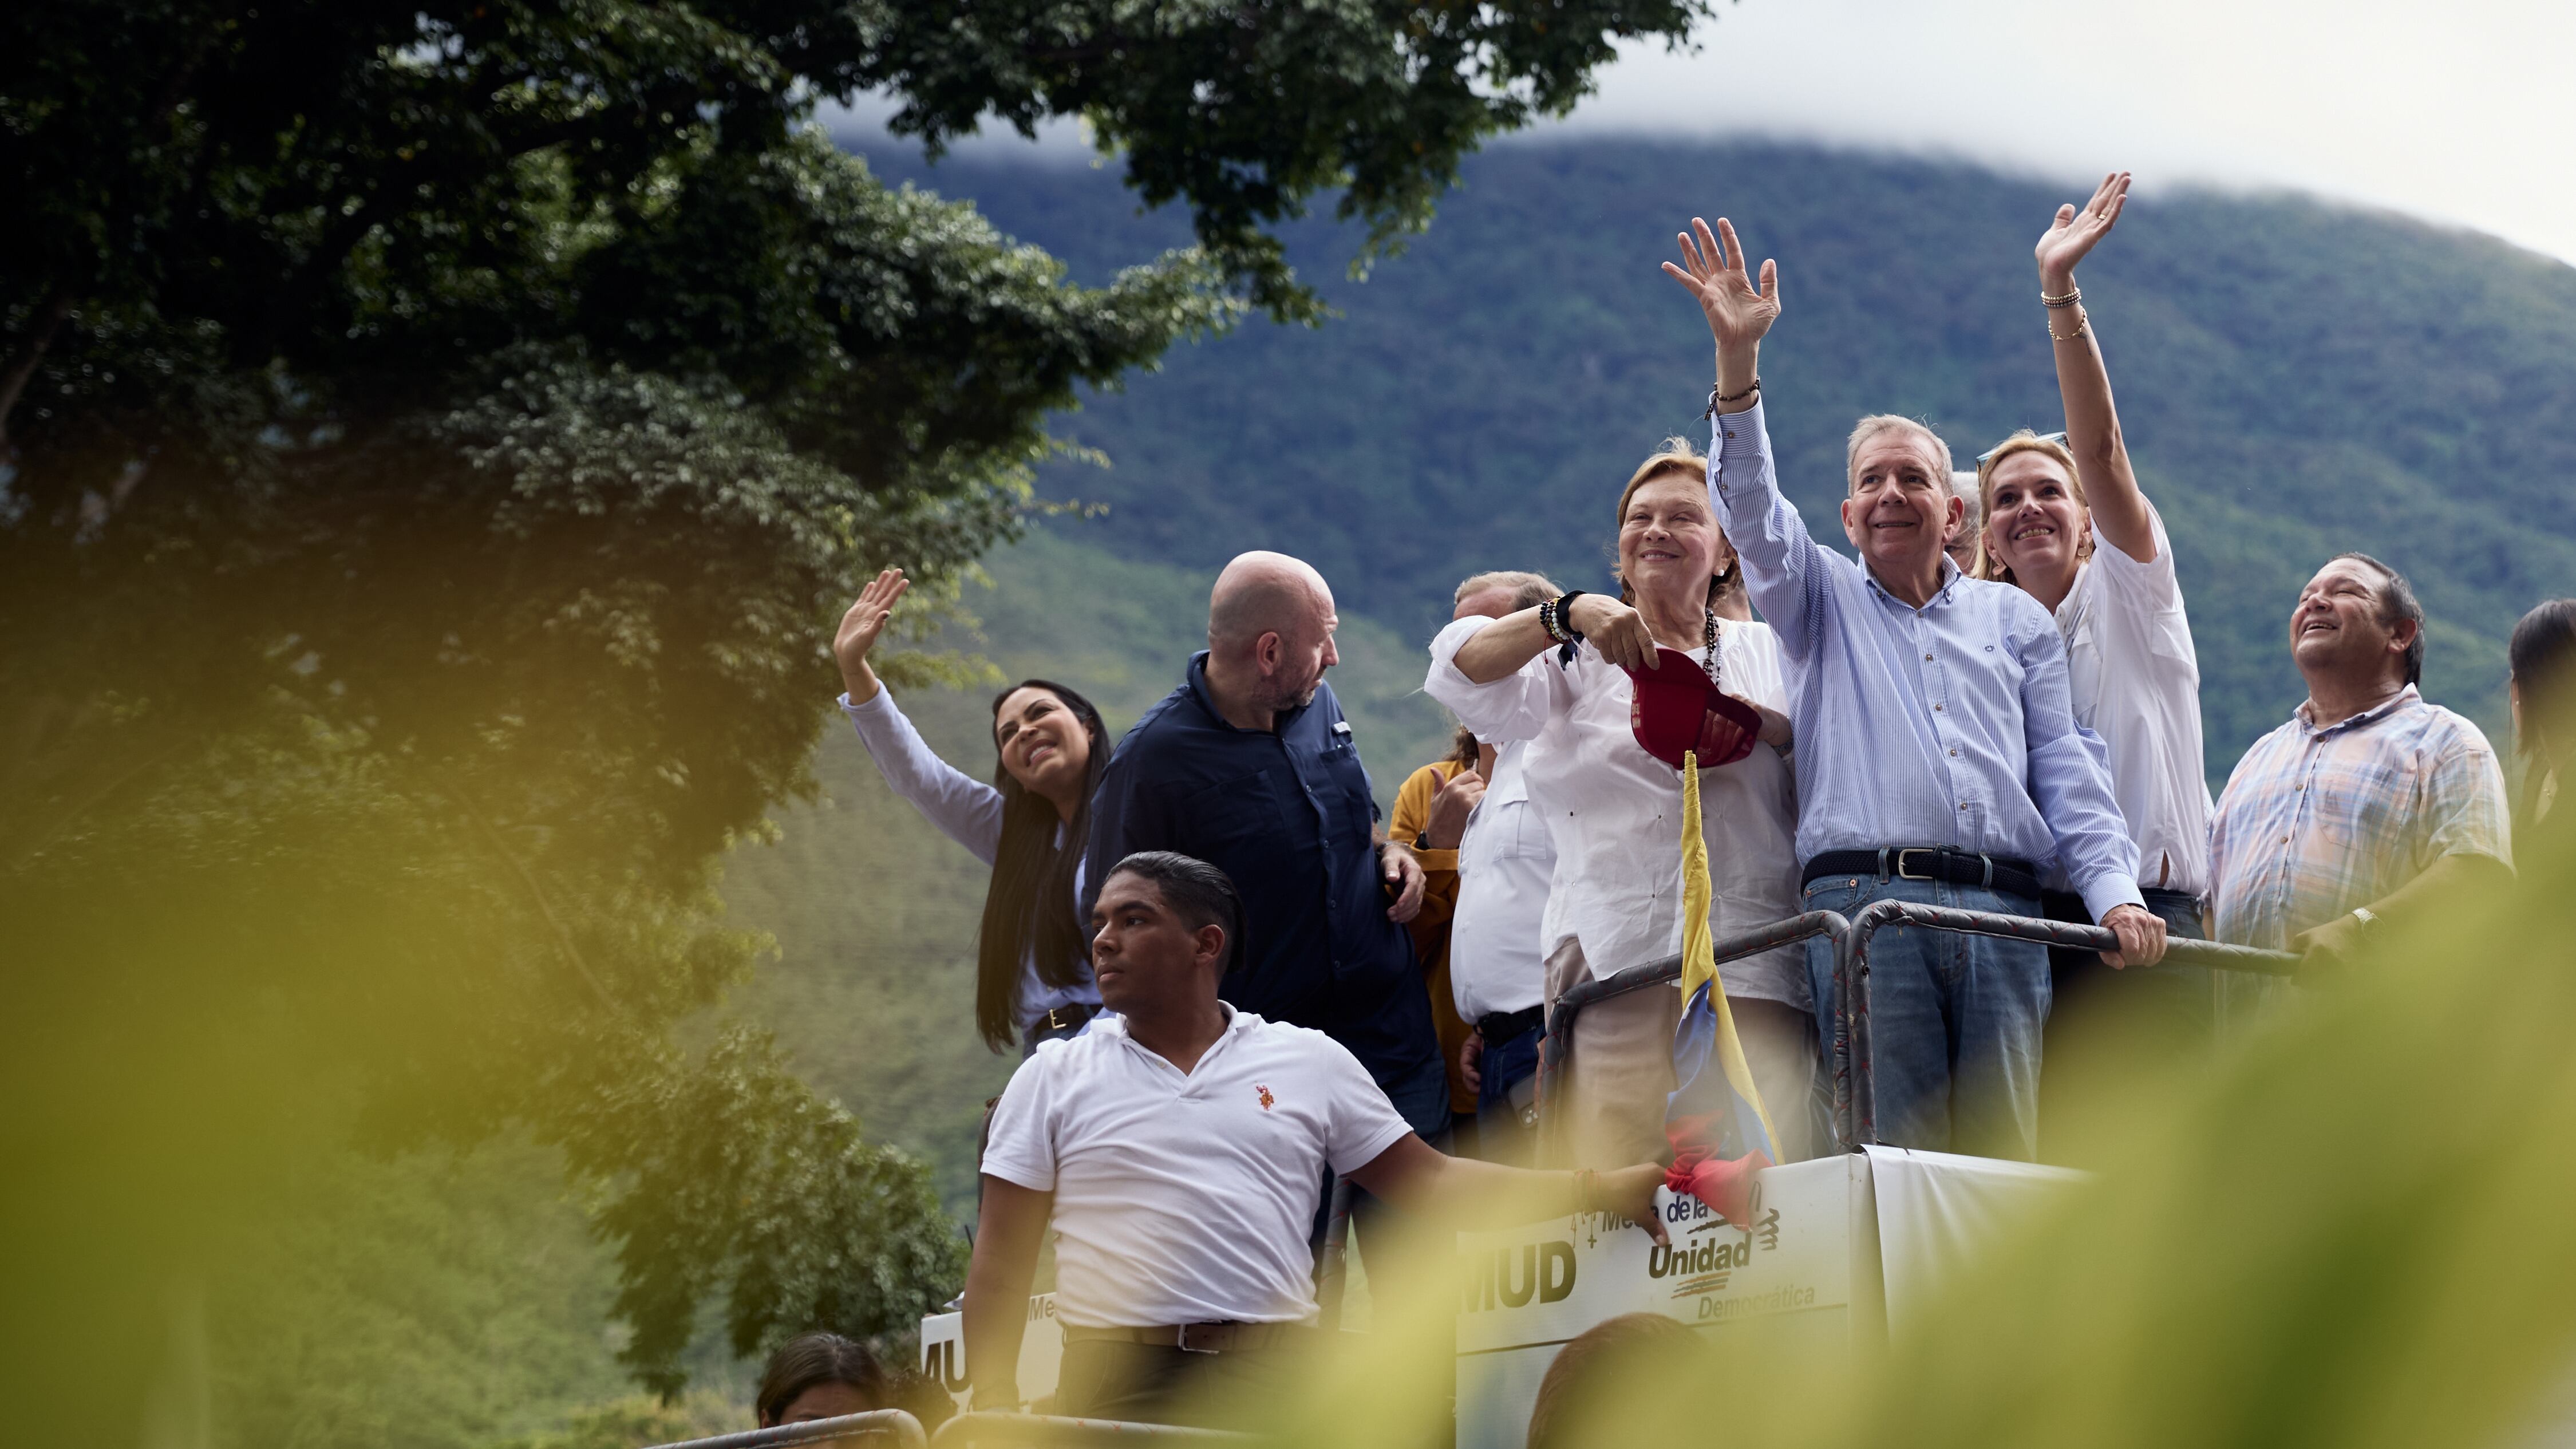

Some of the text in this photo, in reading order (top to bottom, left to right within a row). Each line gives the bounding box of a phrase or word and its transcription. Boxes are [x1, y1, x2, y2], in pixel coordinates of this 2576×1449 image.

[1667, 1195, 1690, 1223] de
[1693, 1195, 1708, 1219] la
[1649, 1231, 1752, 1279] Unidad
[1698, 1284, 1815, 1319] Democrática
